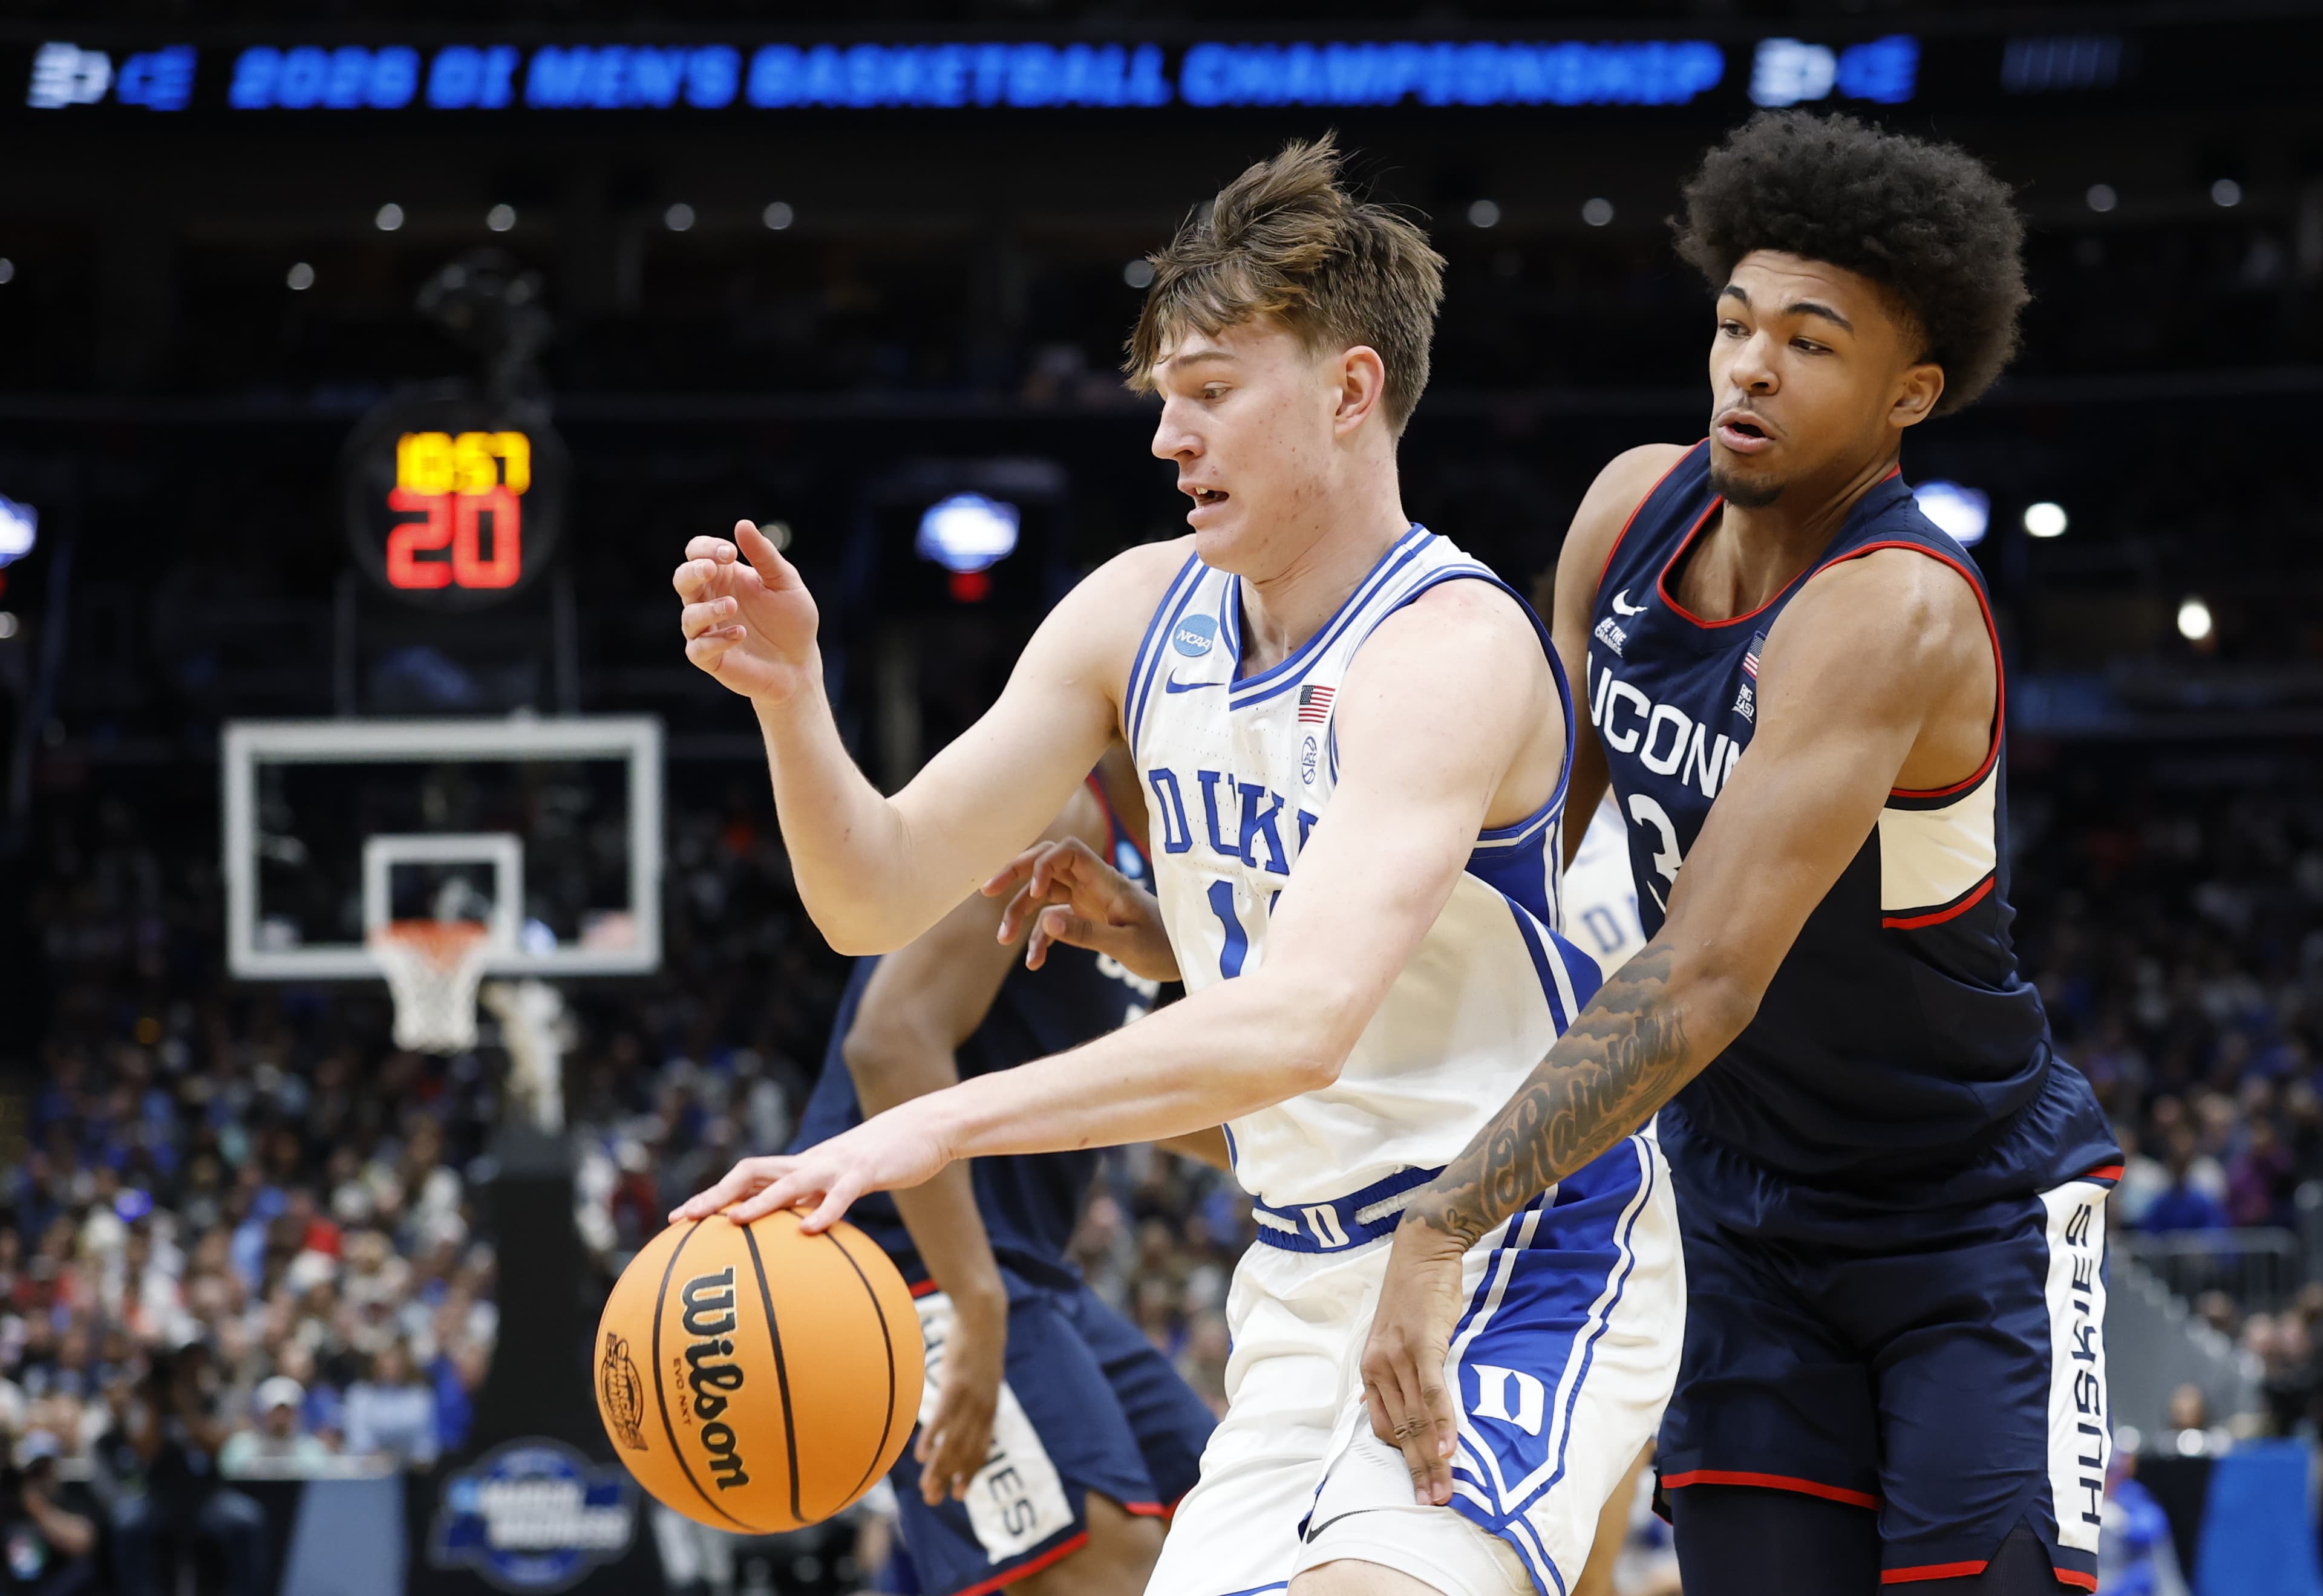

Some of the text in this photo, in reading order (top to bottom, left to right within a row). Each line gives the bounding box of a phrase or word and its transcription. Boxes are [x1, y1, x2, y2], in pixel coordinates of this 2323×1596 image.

[746, 42, 1172, 108] BASKETBALL
[1178, 41, 1726, 107] CHAMPIONSHIP
[387, 484, 521, 589] 20
[1176, 629, 1212, 651] NCAA
[1610, 625, 1627, 647] THE
[1735, 694, 1754, 717] EAST
[1739, 683, 1753, 702] BIG
[1304, 752, 1316, 764] ACC
[680, 1265, 750, 1492] Wilson
[2066, 1203, 2104, 1527] HUSKIES
[673, 1357, 692, 1426] EVO NXT
